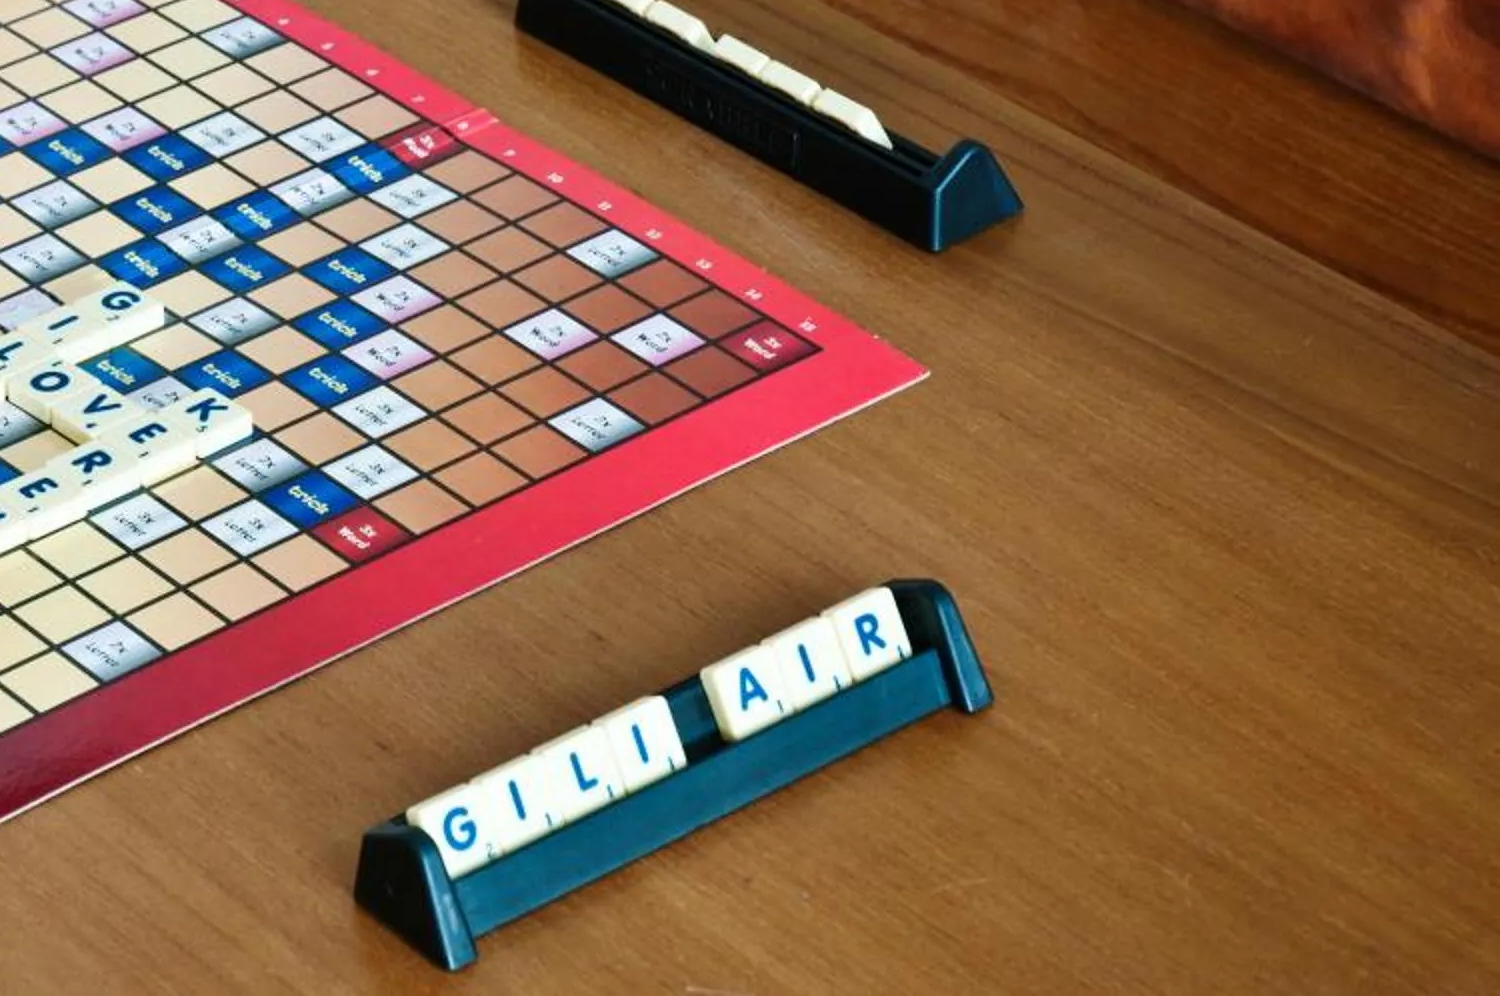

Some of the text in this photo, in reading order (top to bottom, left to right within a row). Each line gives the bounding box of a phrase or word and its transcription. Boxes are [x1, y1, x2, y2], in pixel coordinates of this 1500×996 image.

[48, 139, 84, 164] trick
[147, 145, 184, 170] trick
[347, 155, 382, 182] trick
[135, 197, 172, 222] trick
[236, 202, 272, 230] trick
[123, 250, 158, 277] trick
[224, 256, 262, 281] trick
[327, 259, 366, 283] trick
[318, 311, 356, 337] trick
[201, 363, 242, 388] trick
[308, 367, 348, 394] trick
[288, 485, 328, 514] trick
